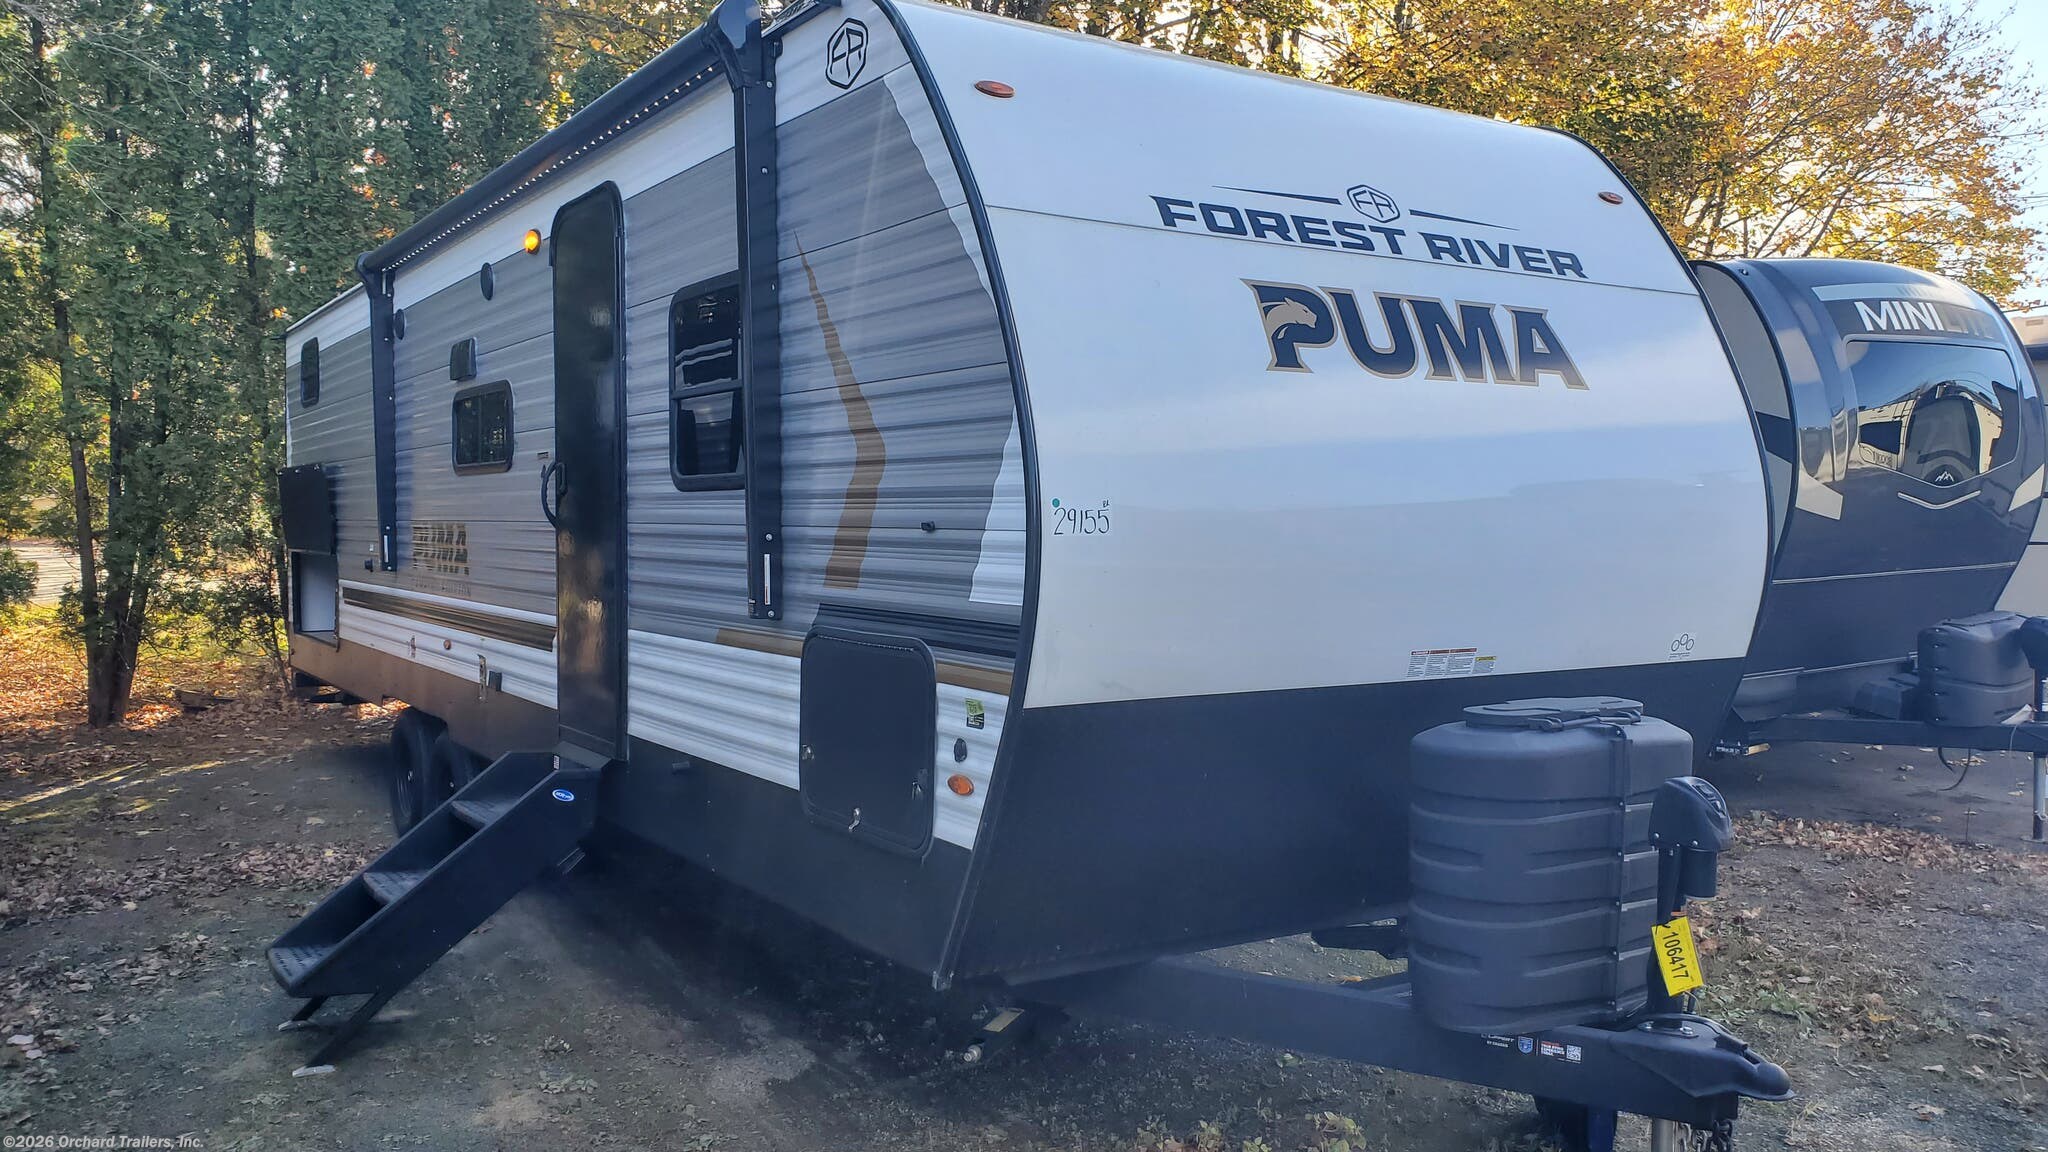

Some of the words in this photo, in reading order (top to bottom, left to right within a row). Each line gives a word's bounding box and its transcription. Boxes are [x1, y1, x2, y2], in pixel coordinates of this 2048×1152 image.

[1149, 195, 1406, 254] FOREST
[1417, 231, 1589, 279] RIVER
[1240, 278, 1590, 391] PUMA
[1854, 301, 1945, 332] MINI
[1663, 931, 1689, 978] 106417
